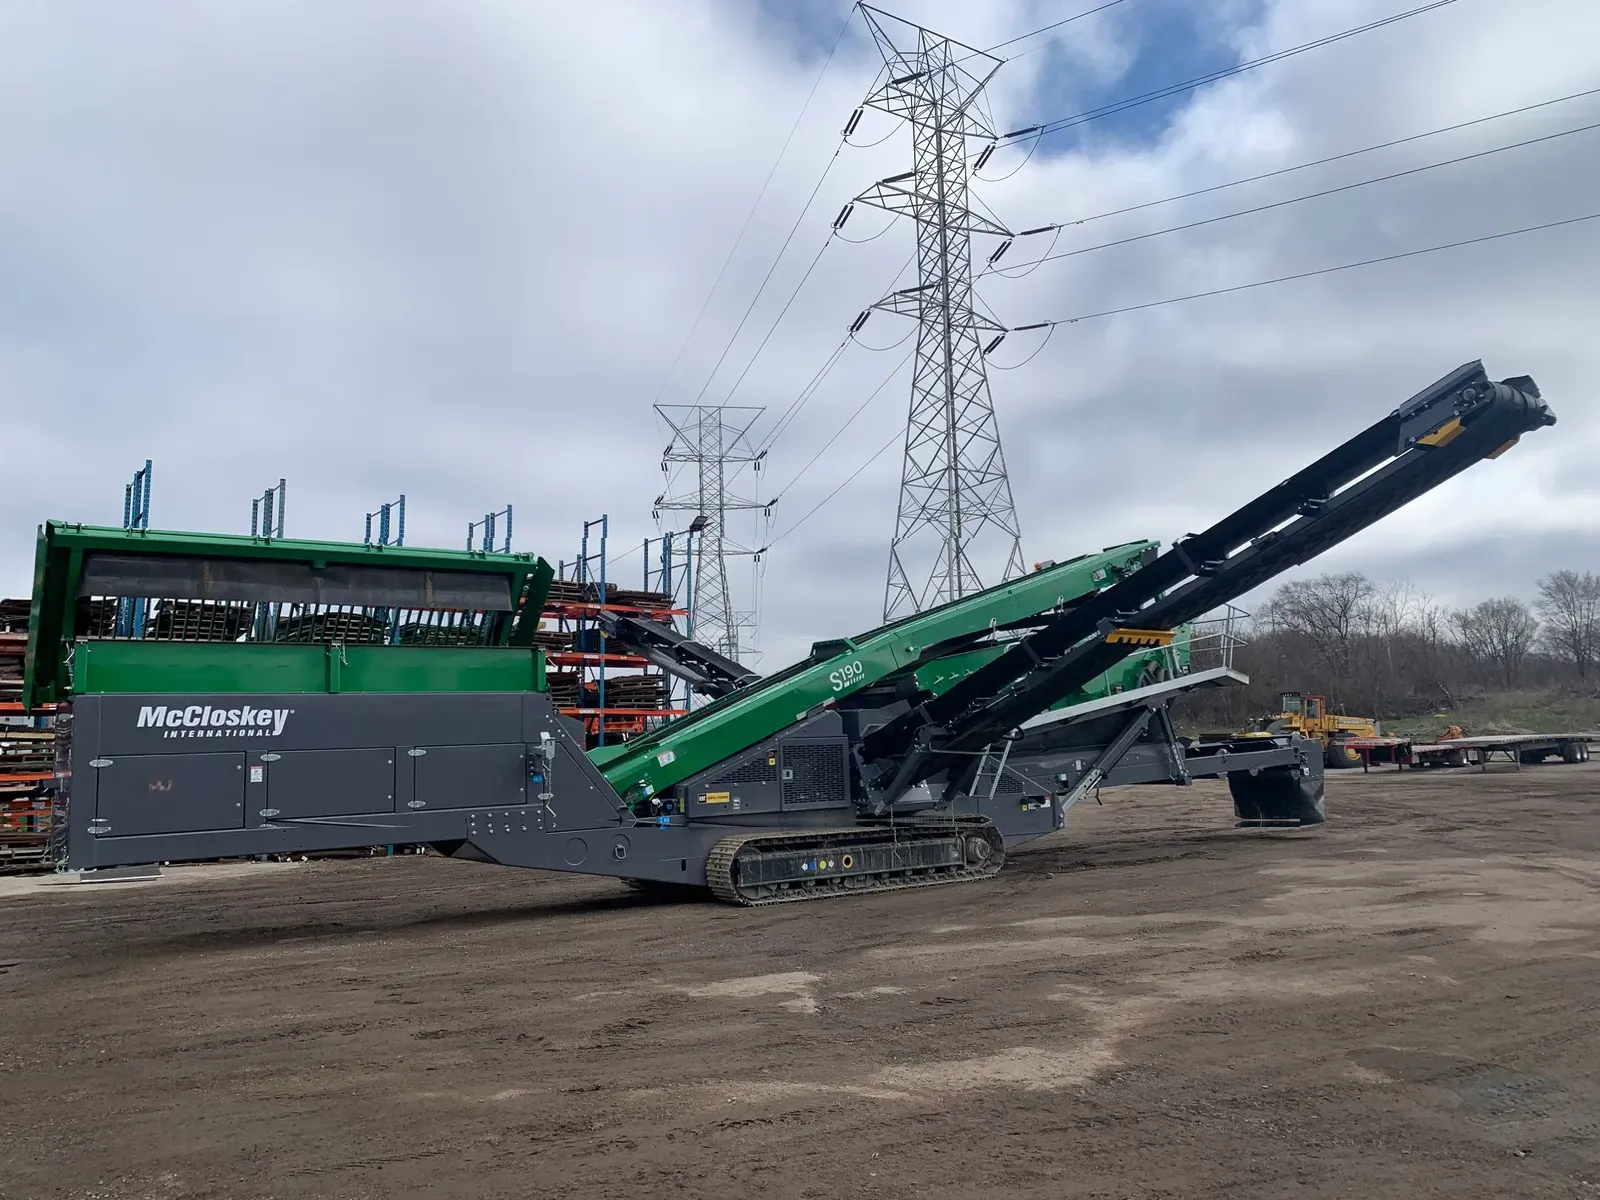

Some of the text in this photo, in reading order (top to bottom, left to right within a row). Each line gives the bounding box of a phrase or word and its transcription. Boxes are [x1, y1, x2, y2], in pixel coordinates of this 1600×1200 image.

[829, 661, 863, 692] S190
[136, 705, 289, 736] McCloskey
[163, 729, 271, 739] INTERNATIONAL
